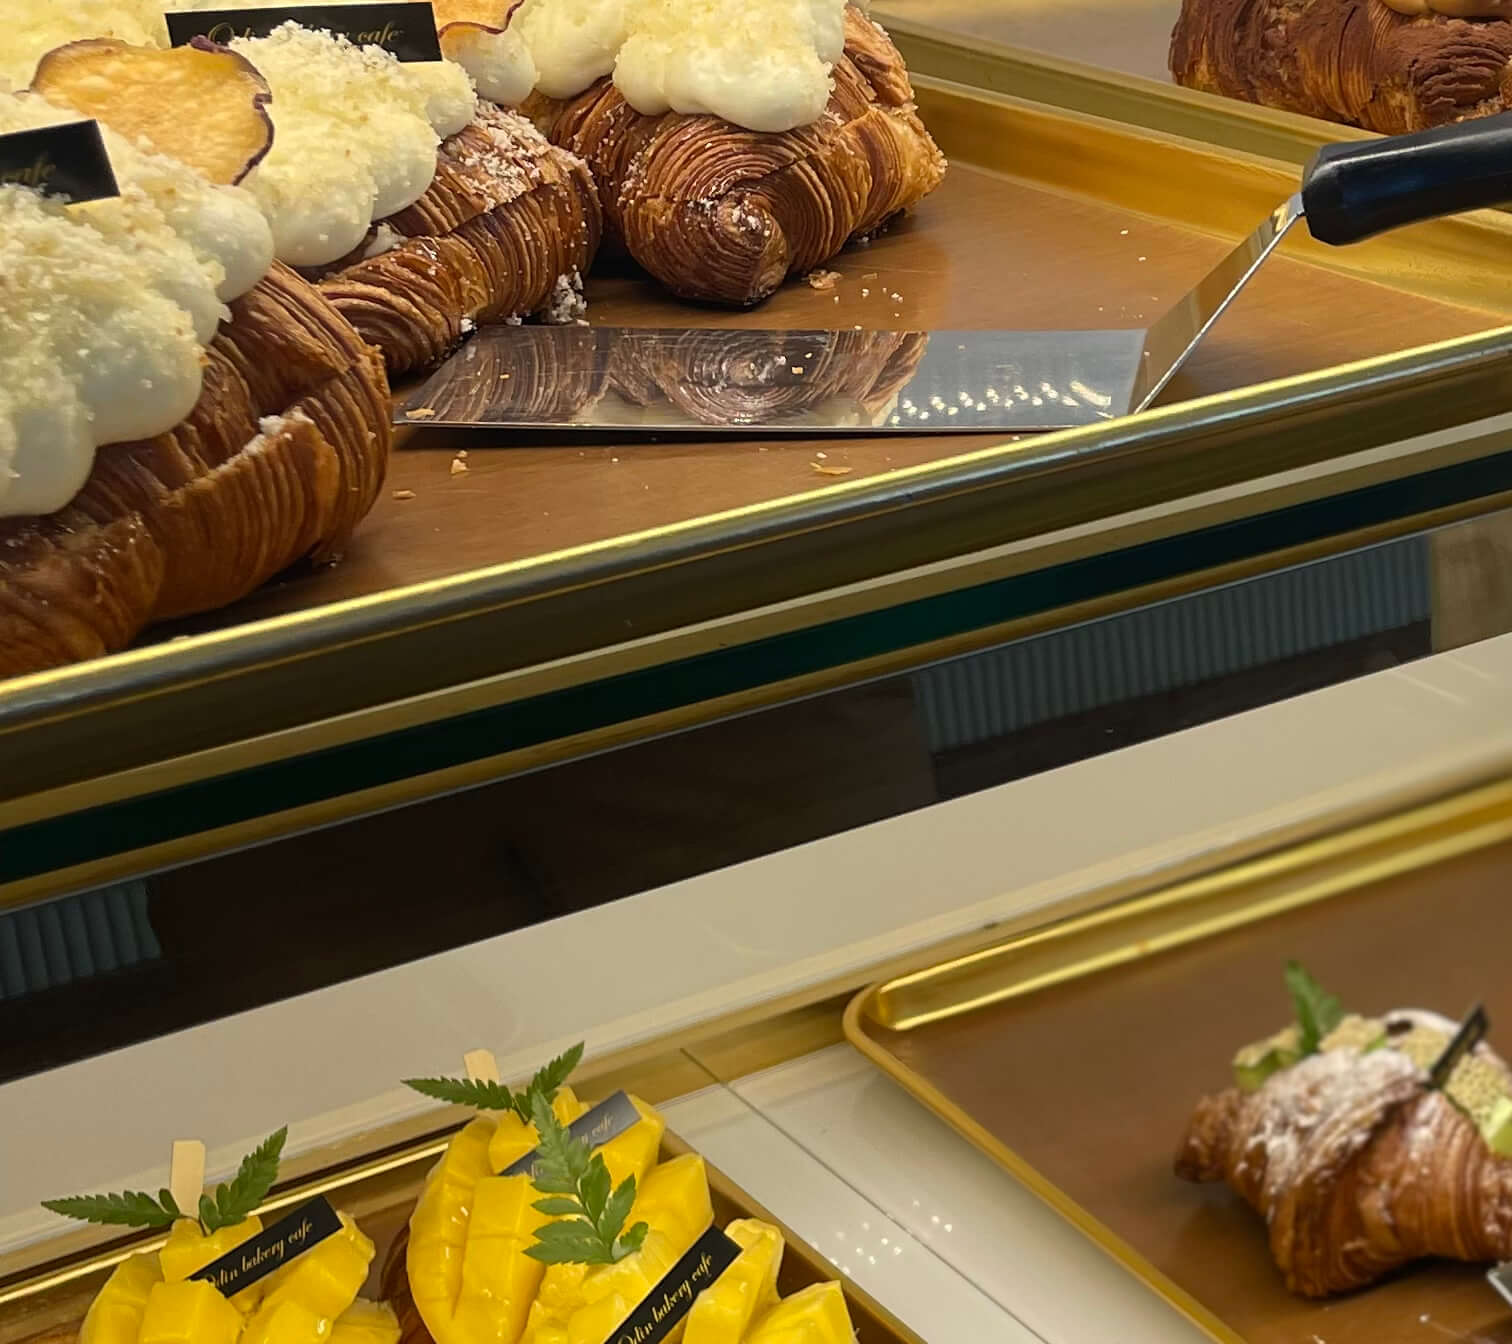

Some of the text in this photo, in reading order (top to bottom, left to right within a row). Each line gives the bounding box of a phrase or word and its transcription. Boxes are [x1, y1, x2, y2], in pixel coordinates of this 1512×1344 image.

[357, 21, 401, 45] cafe
[241, 1238, 285, 1273] bakery
[287, 1216, 313, 1244] cafe
[651, 1278, 693, 1324] bakery
[691, 1252, 713, 1279] cafe
